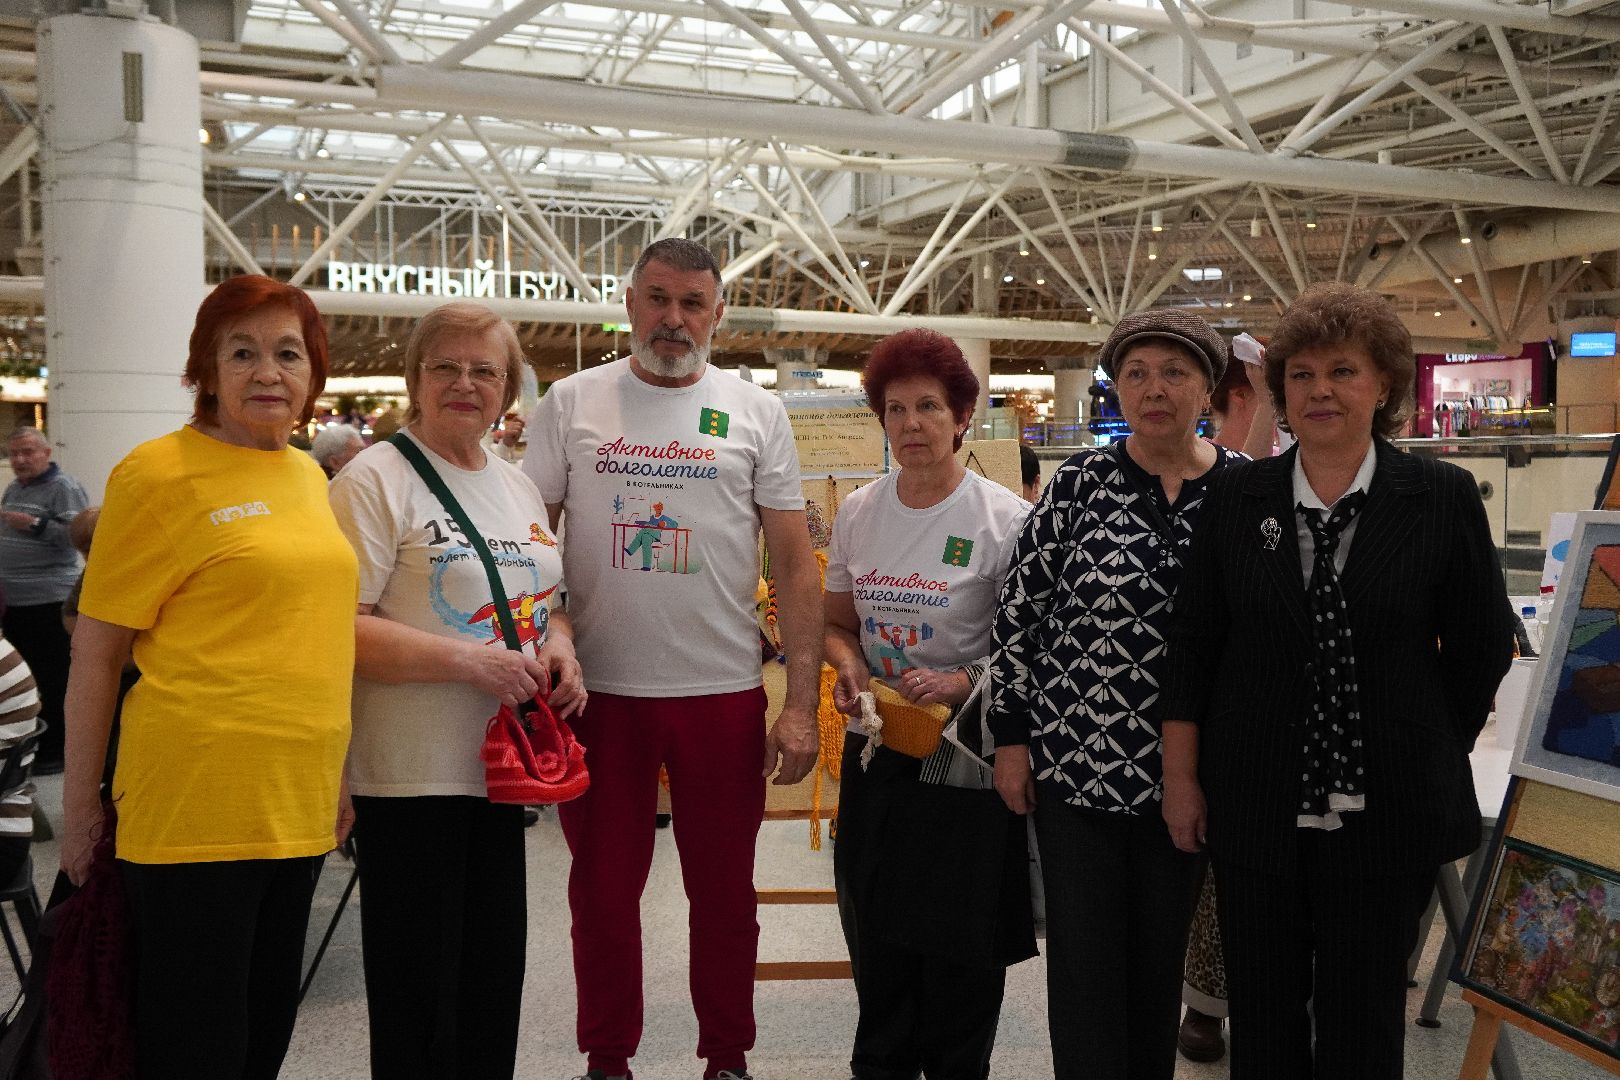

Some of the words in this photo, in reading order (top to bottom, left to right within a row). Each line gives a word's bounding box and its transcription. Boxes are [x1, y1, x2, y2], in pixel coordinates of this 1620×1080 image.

[328, 259, 496, 298] ВКУСНЫЙ
[596, 436, 716, 461] Активное
[595, 453, 718, 480] долголетие
[429, 553, 470, 565] полет
[855, 568, 948, 592] Активное
[854, 583, 950, 608] долголетие
